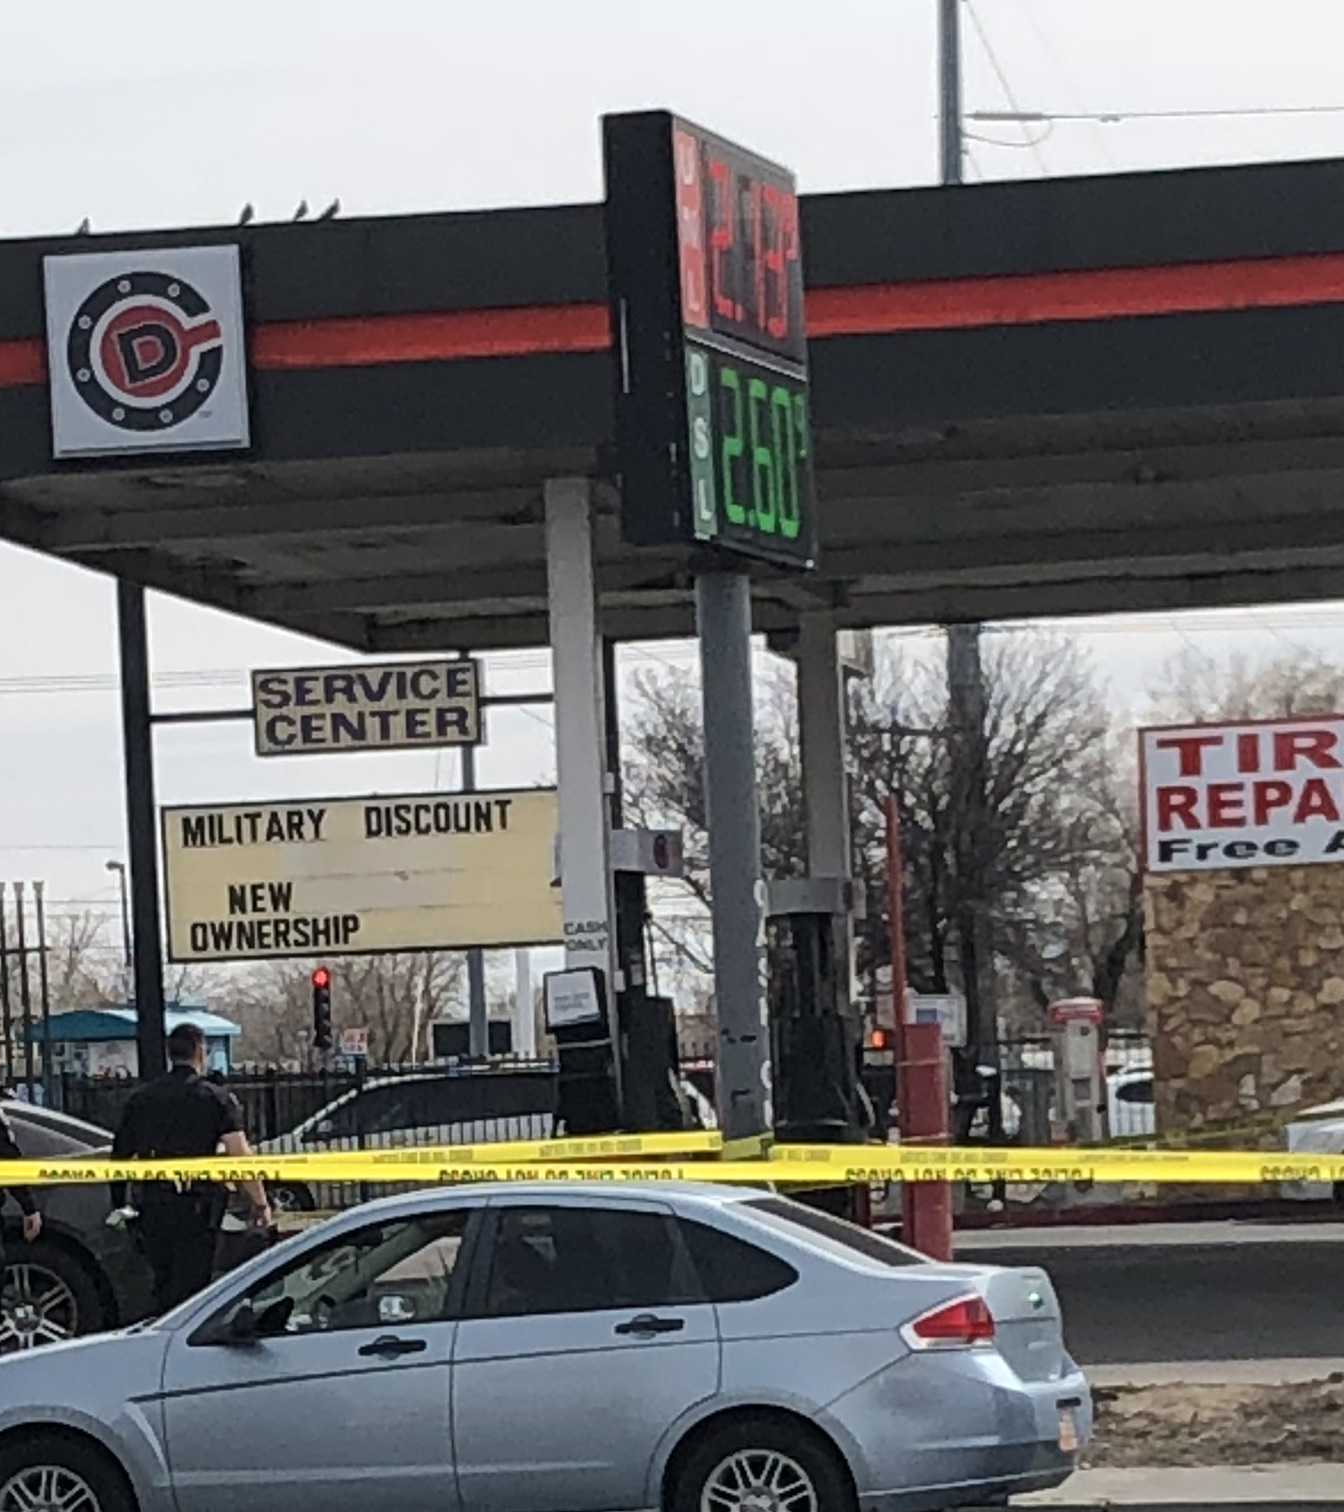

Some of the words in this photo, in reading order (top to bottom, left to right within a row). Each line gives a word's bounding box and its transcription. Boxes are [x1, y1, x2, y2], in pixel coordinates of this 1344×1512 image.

[258, 666, 472, 709] SERVICE
[264, 706, 471, 748] CENTER
[181, 808, 328, 848] MILITARY
[364, 800, 513, 840] DISCOUNT
[1157, 836, 1300, 863] Free
[228, 881, 293, 915] NEW
[190, 914, 360, 952] OWNERSHIP
[563, 920, 609, 936] CASH
